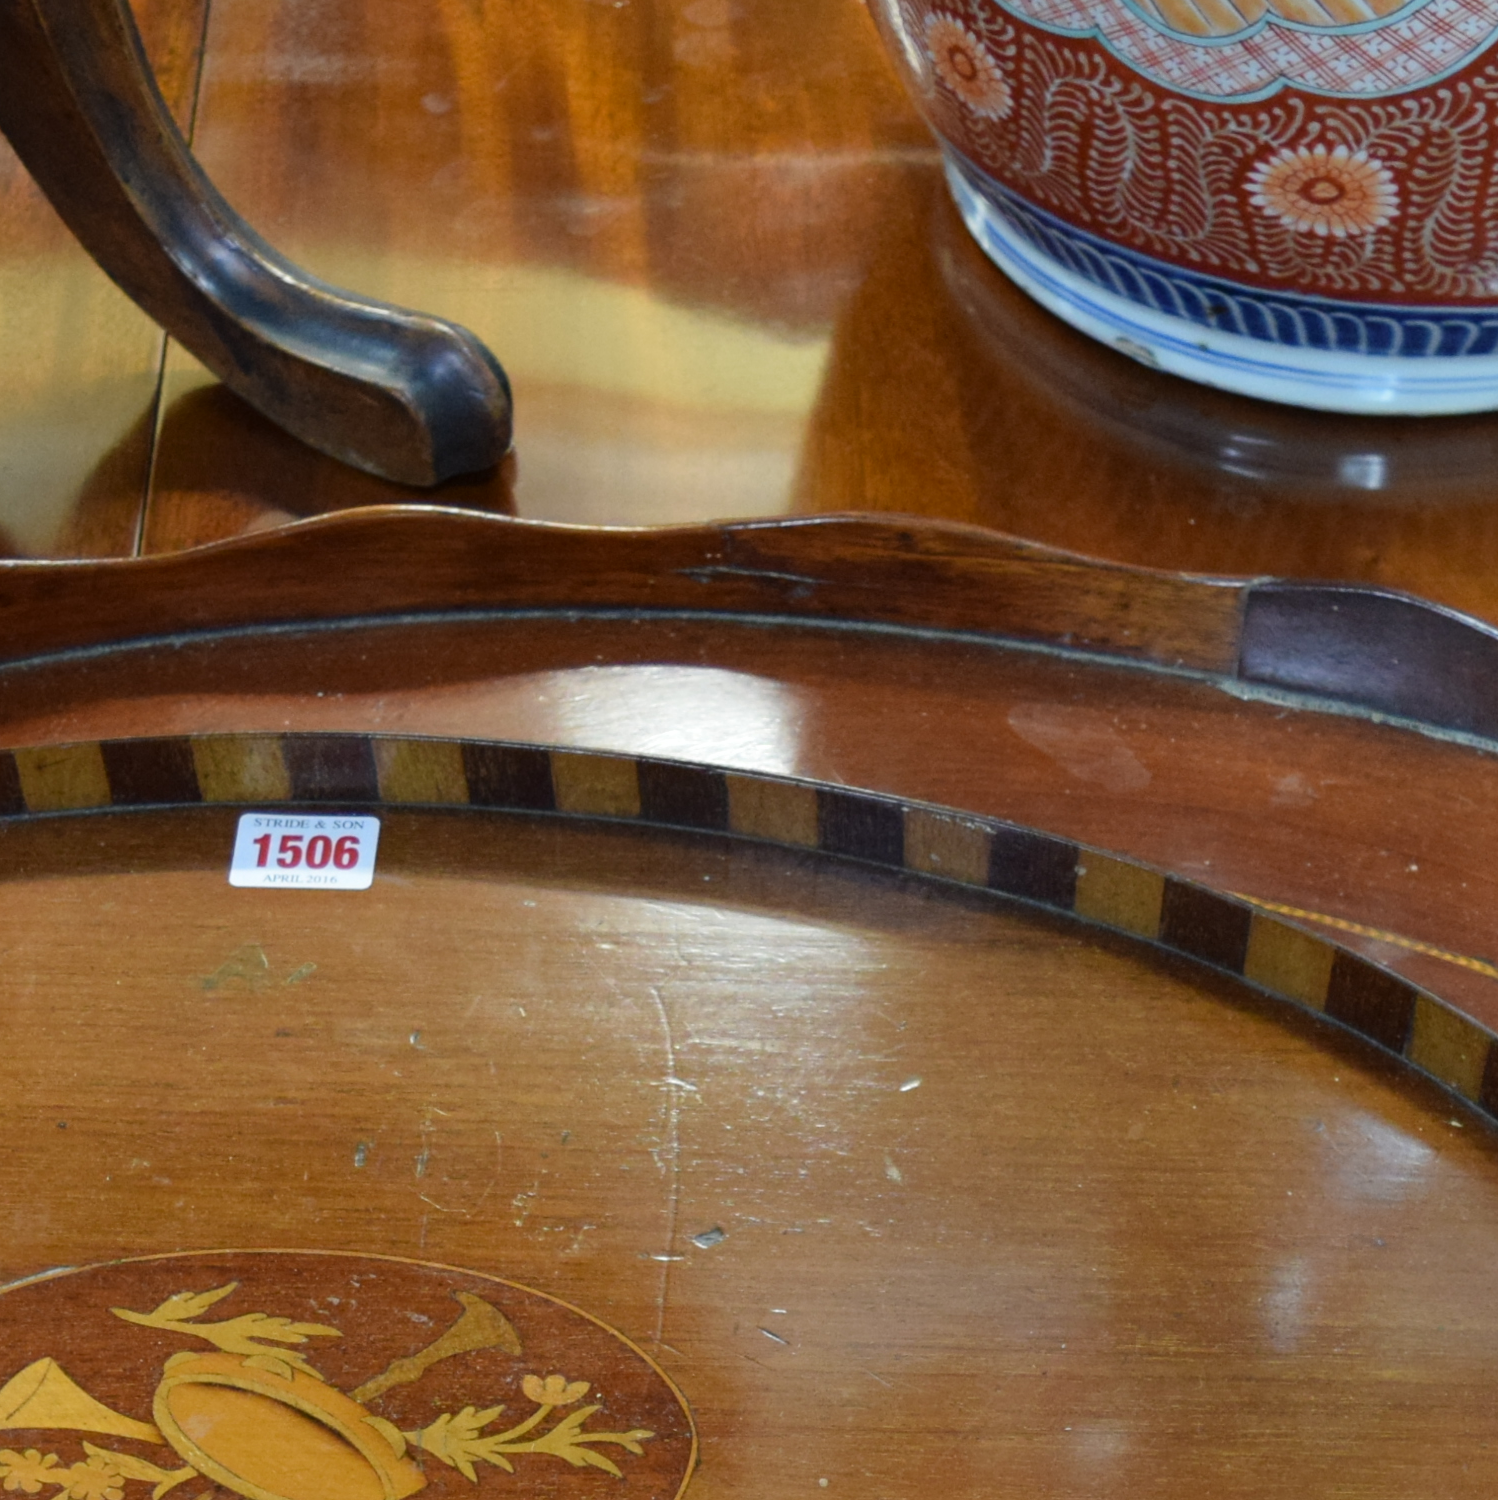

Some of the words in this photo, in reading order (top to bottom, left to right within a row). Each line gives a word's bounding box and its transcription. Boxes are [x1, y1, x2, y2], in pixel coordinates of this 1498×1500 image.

[254, 817, 310, 829] STRIDE
[314, 820, 326, 829] &
[332, 820, 365, 829] SON
[253, 833, 361, 870] 1506
[263, 874, 303, 883] APRIL
[306, 875, 338, 884] 2016
